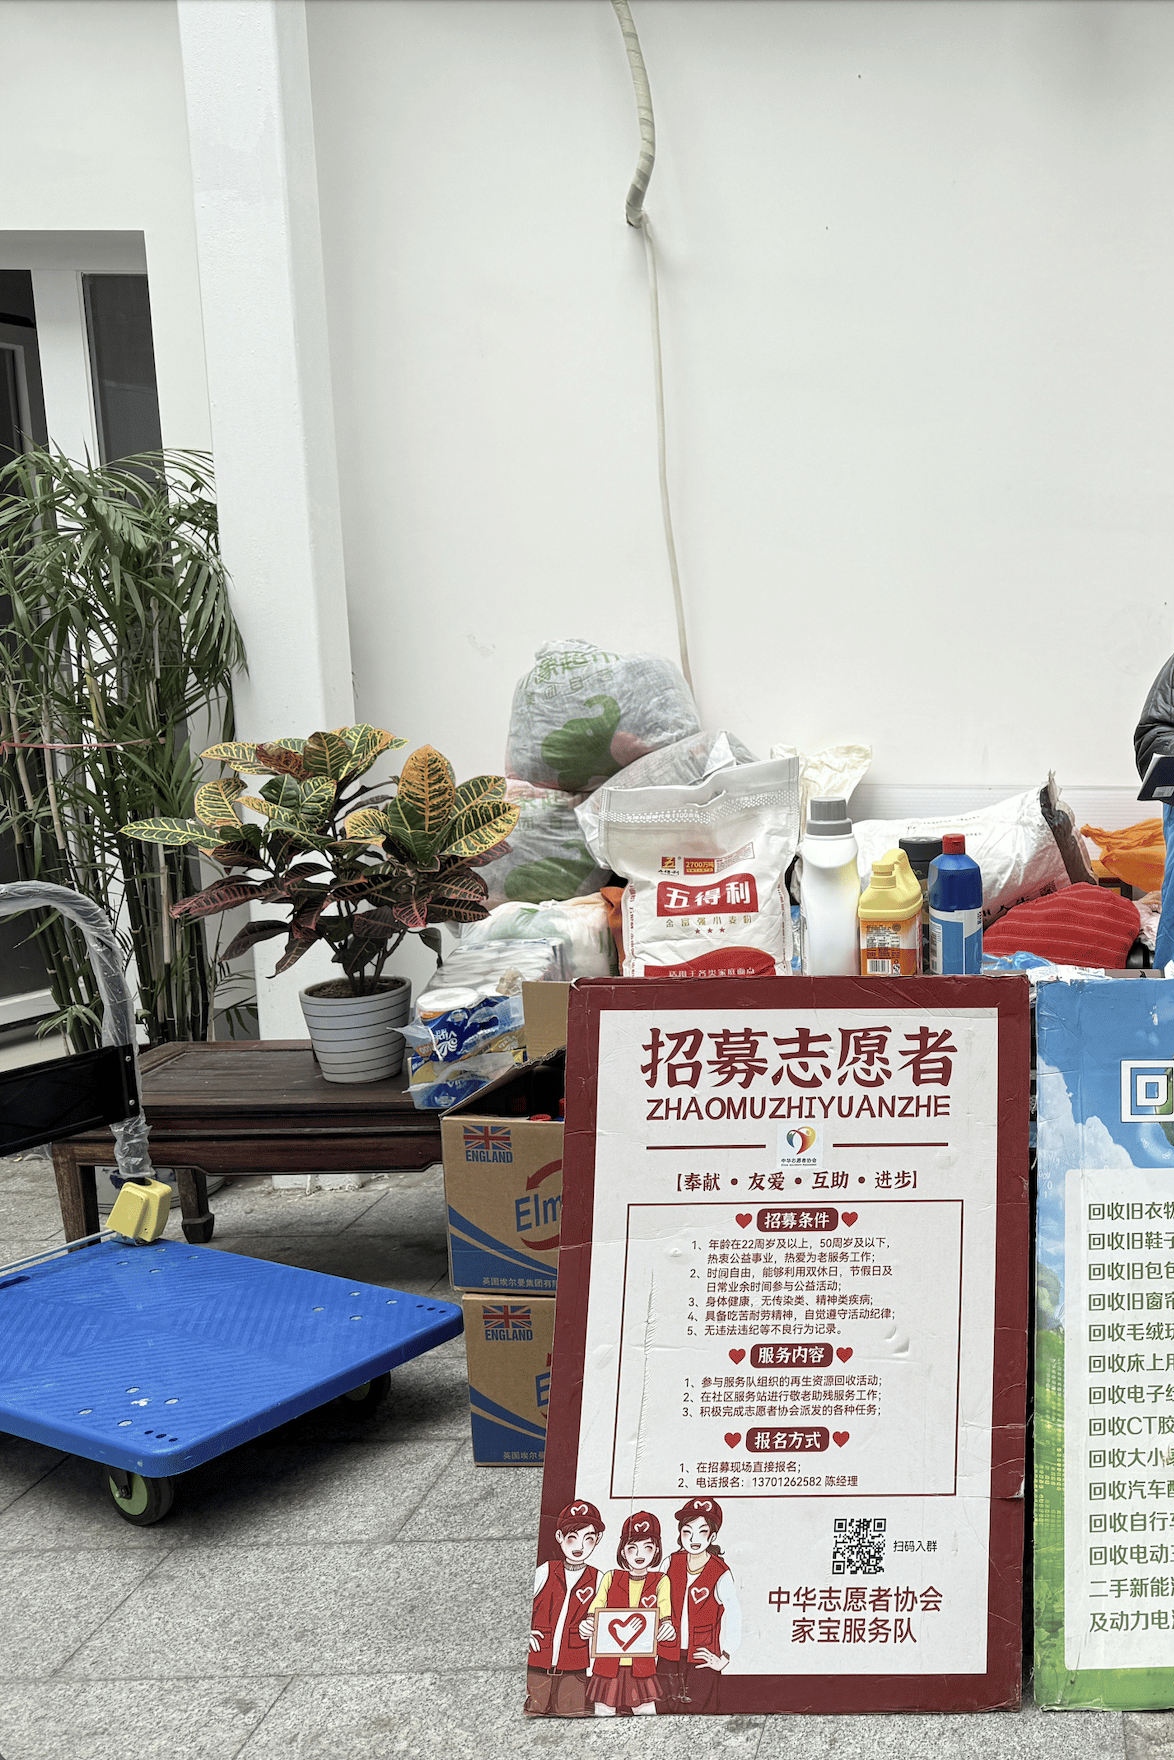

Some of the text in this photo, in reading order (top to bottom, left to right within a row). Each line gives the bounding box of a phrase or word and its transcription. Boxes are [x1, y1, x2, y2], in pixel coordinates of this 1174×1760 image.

[664, 881, 751, 908] 五得利
[641, 1026, 958, 1089] 招募志愿者
[646, 1095, 950, 1120] ZHAOMUZHIYUANZHE
[465, 1150, 513, 1164] ENGLAND
[748, 1172, 785, 1191] 友爱
[812, 1171, 849, 1189] 互助
[765, 1212, 829, 1228] 招募条件
[484, 1329, 533, 1341] ENGLAND
[758, 1346, 824, 1363] 服务内容
[755, 1432, 821, 1449] 报名方式
[825, 1475, 858, 1487] 陈经理
[893, 1540, 937, 1552] 扫码入群
[769, 1586, 943, 1612] 中华志愿者协会
[791, 1617, 917, 1643] 家宝服务队
